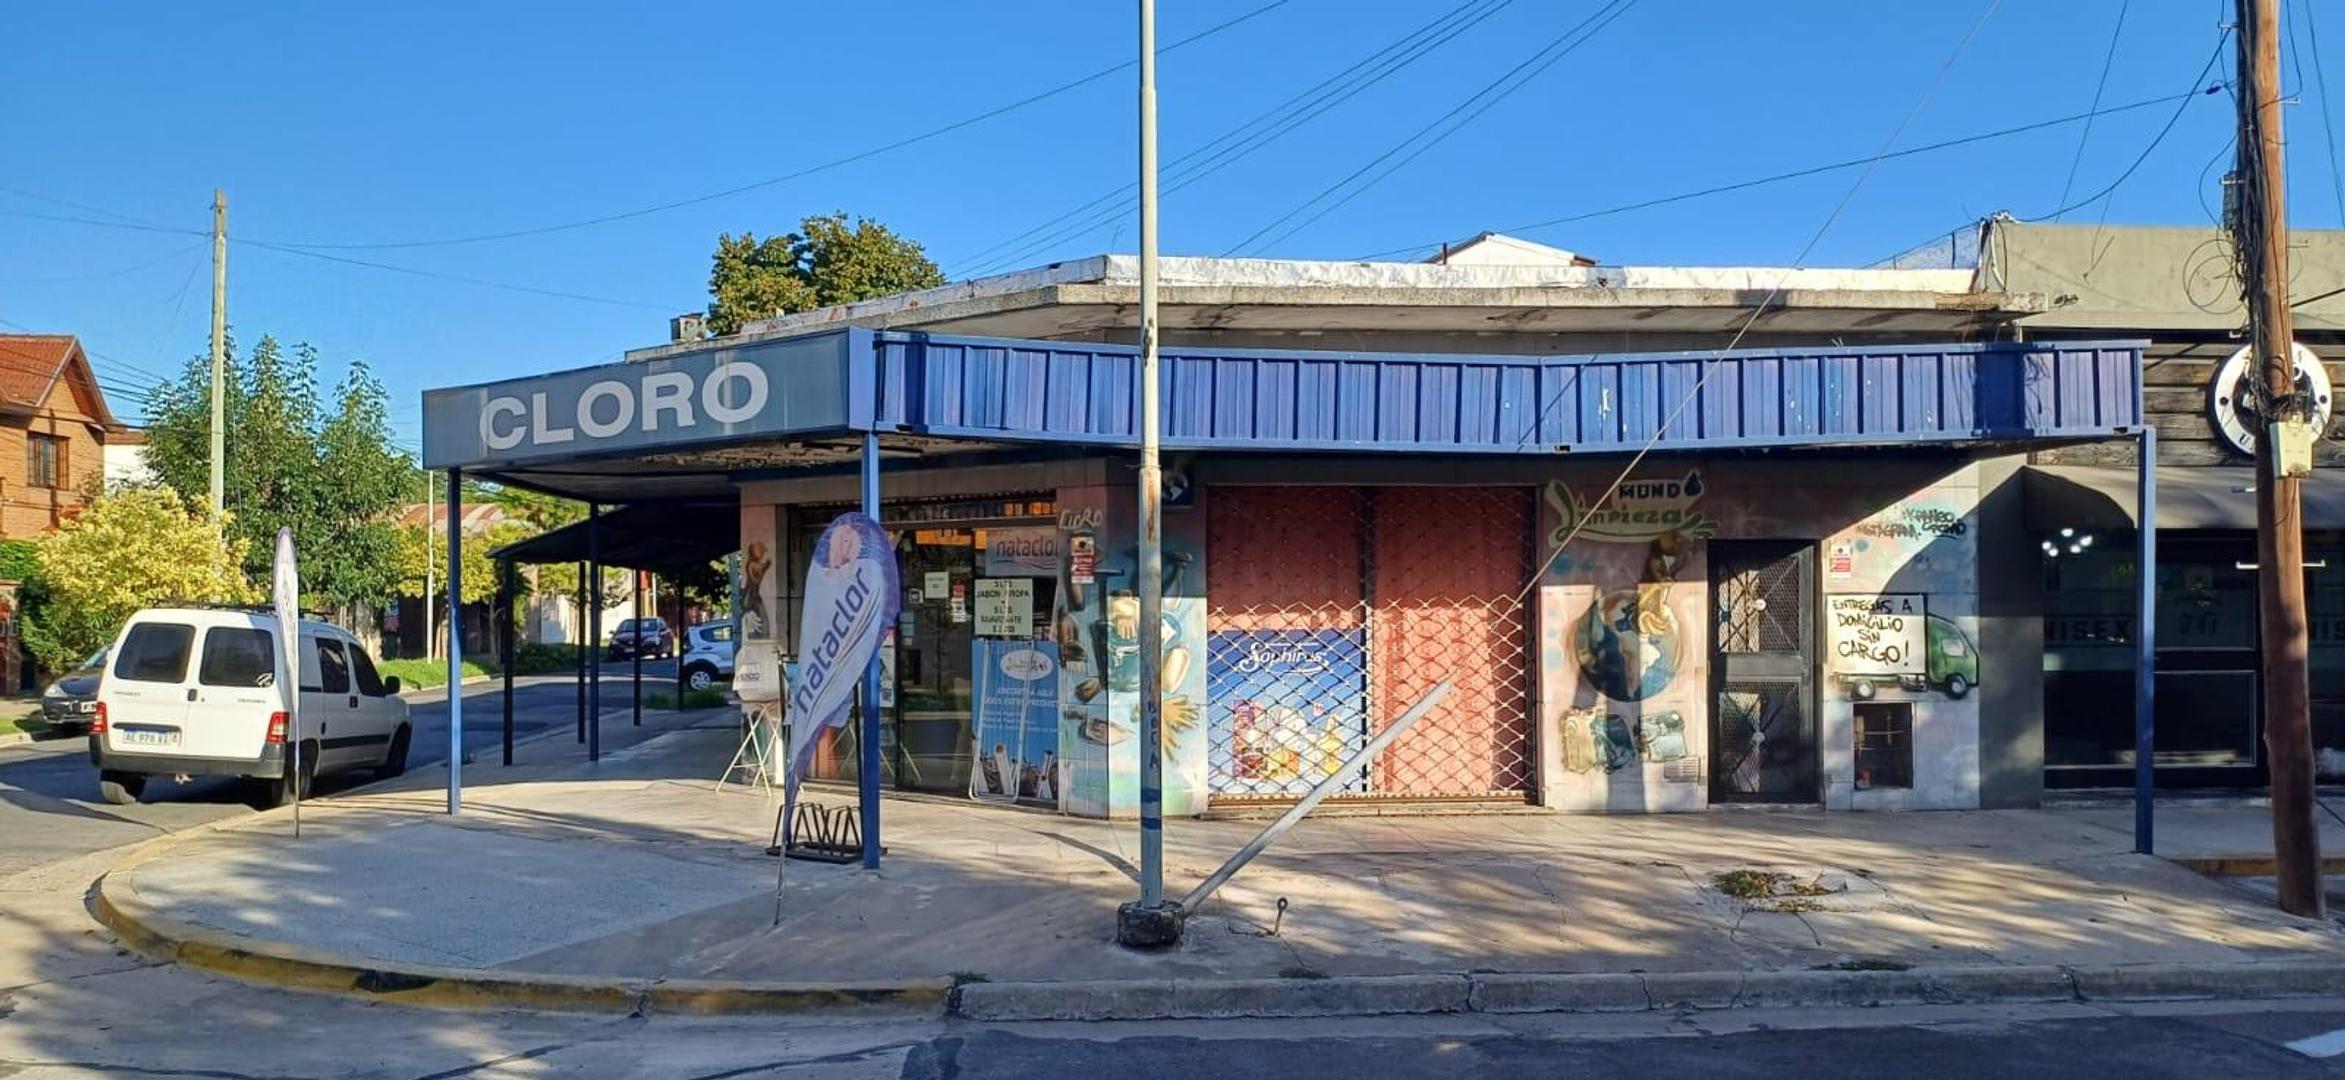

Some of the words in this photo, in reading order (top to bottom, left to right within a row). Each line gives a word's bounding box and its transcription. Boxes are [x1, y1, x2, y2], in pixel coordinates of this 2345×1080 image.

[480, 362, 768, 449] CLORO
[794, 568, 870, 714] nataclor
[1902, 598, 1913, 614] A
